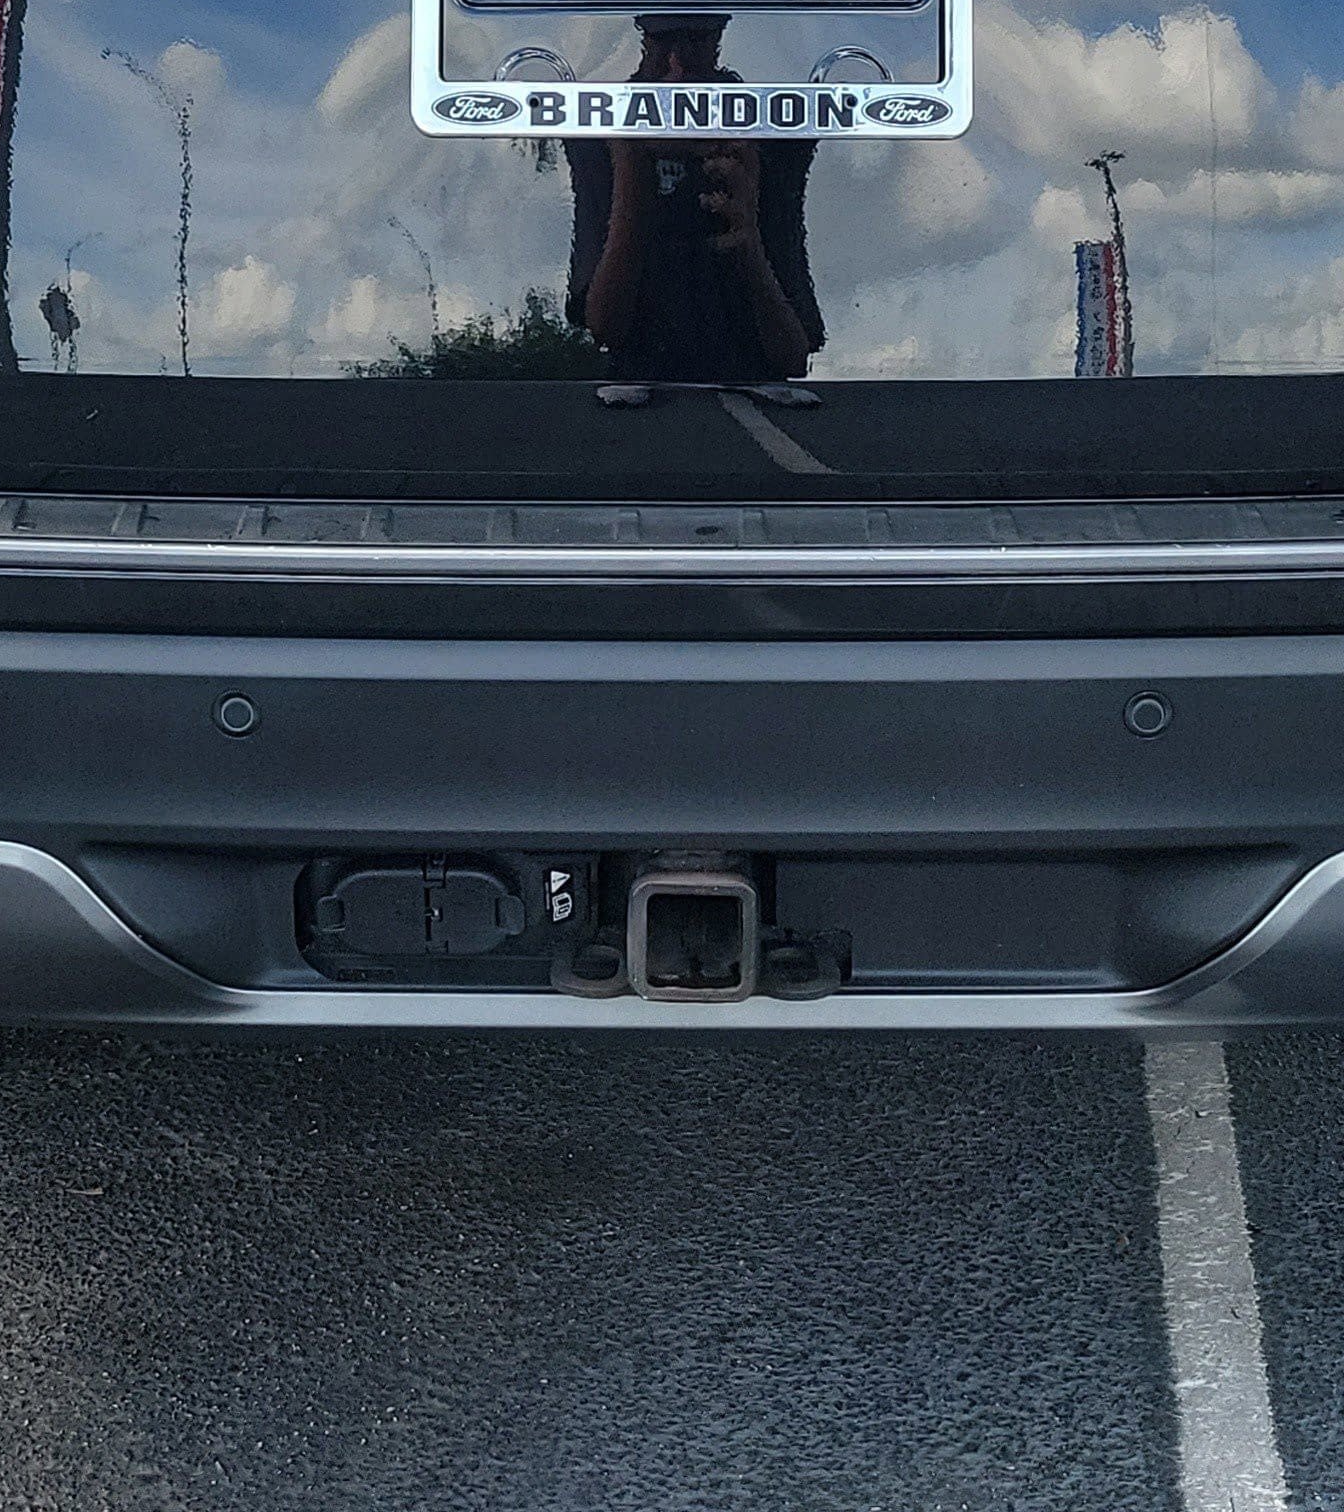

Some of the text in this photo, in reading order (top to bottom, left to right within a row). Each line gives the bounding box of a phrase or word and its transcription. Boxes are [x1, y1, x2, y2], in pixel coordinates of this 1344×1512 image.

[449, 91, 936, 128] Ford BRANDON Ford
